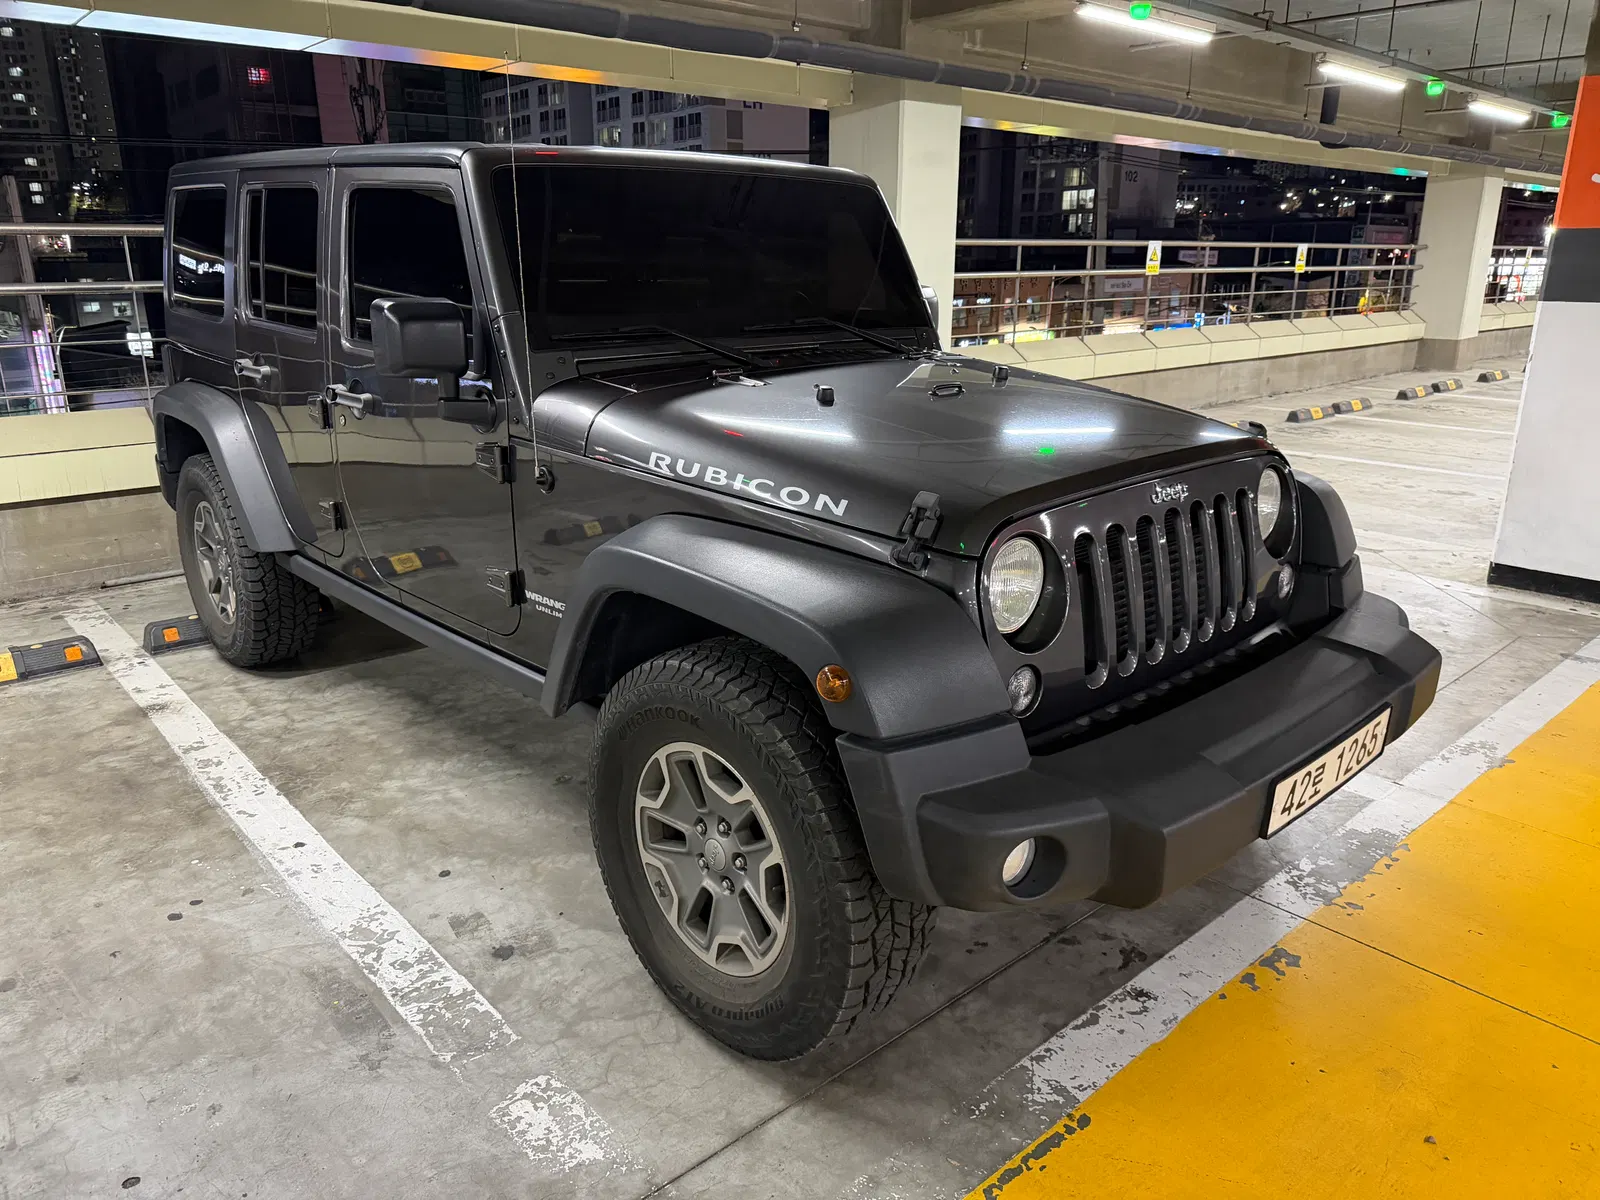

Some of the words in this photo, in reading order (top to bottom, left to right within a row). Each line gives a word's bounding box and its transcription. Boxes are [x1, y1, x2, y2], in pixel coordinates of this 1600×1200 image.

[1125, 169, 1139, 182] 102
[649, 451, 848, 516] RUBICON
[1150, 482, 1188, 504] Jeep
[1280, 762, 1327, 816] 42로
[1335, 720, 1381, 782] 1265
